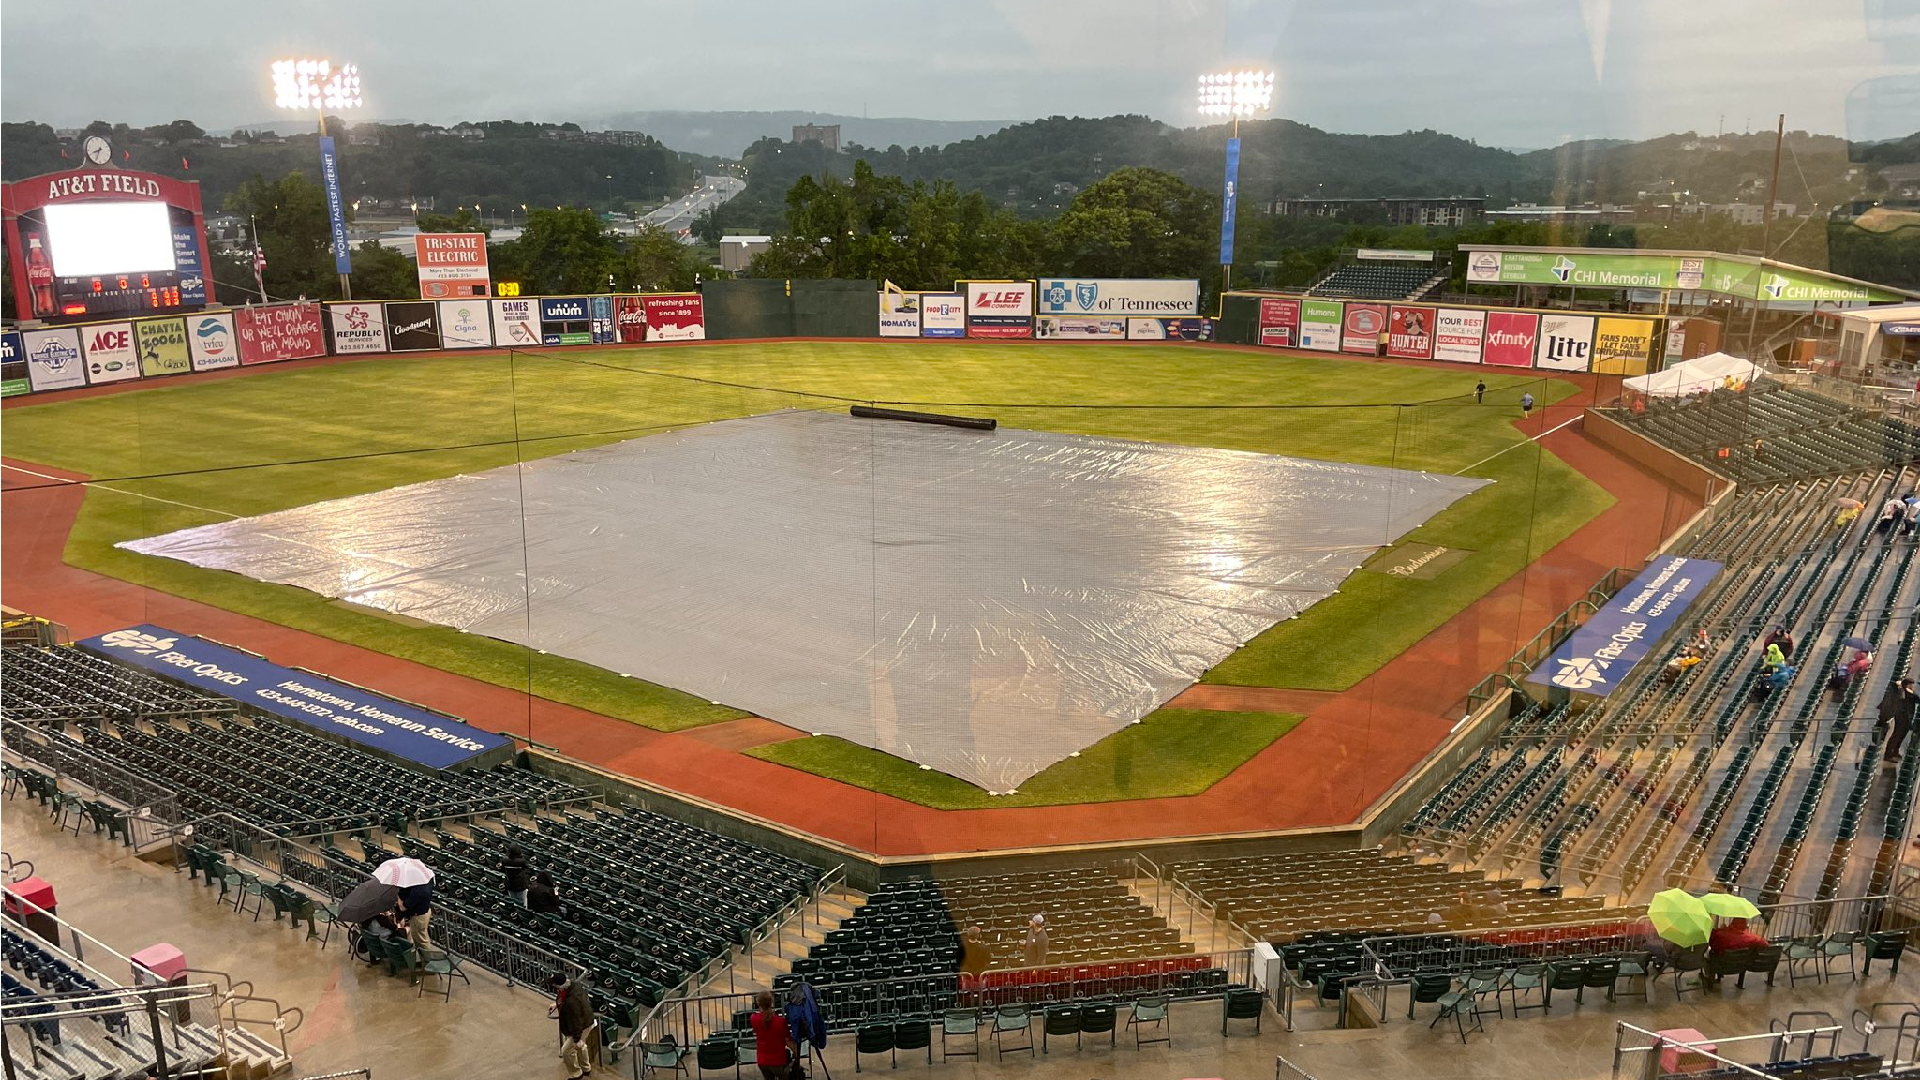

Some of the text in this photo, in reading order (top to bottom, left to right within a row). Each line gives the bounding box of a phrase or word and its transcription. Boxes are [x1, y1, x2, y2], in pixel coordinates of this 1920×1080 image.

[49, 174, 160, 199] AT&T FIELD
[324, 154, 346, 258] WORLD'S FASTEST INTERNET
[425, 238, 478, 249] TRI-STATE
[428, 251, 478, 262] ELECTRIC
[1574, 271, 1660, 286] CHI Memorial
[498, 282, 520, 296] 0:30
[1787, 287, 1868, 299] CHI Memorial
[994, 292, 1024, 303] LEE
[1099, 297, 1193, 310] of Tennessee
[502, 302, 528, 312] GAMES
[548, 303, 582, 316] unum
[1308, 308, 1336, 316] Humana
[255, 312, 272, 325] EAT
[141, 322, 182, 334] CHATTA
[286, 320, 318, 336] CHARGE
[337, 330, 382, 338] REPUBLIC
[90, 330, 128, 352] ACE
[142, 334, 184, 349] ZOOGA
[204, 337, 224, 349] tvfcu
[282, 336, 311, 350] MOUND
[1392, 334, 1429, 349] HUNTER
[1488, 330, 1532, 348] xfinity
[1600, 334, 1646, 344] FANS DON'T
[1546, 335, 1588, 362] Lite
[1596, 348, 1648, 358] DRIVE DRUNK
[1594, 621, 1647, 660] Fiber Optics
[154, 651, 248, 685] Fiber Optics
[277, 680, 484, 751] Hometown, Homerun Service
[334, 715, 385, 736] epb.com
